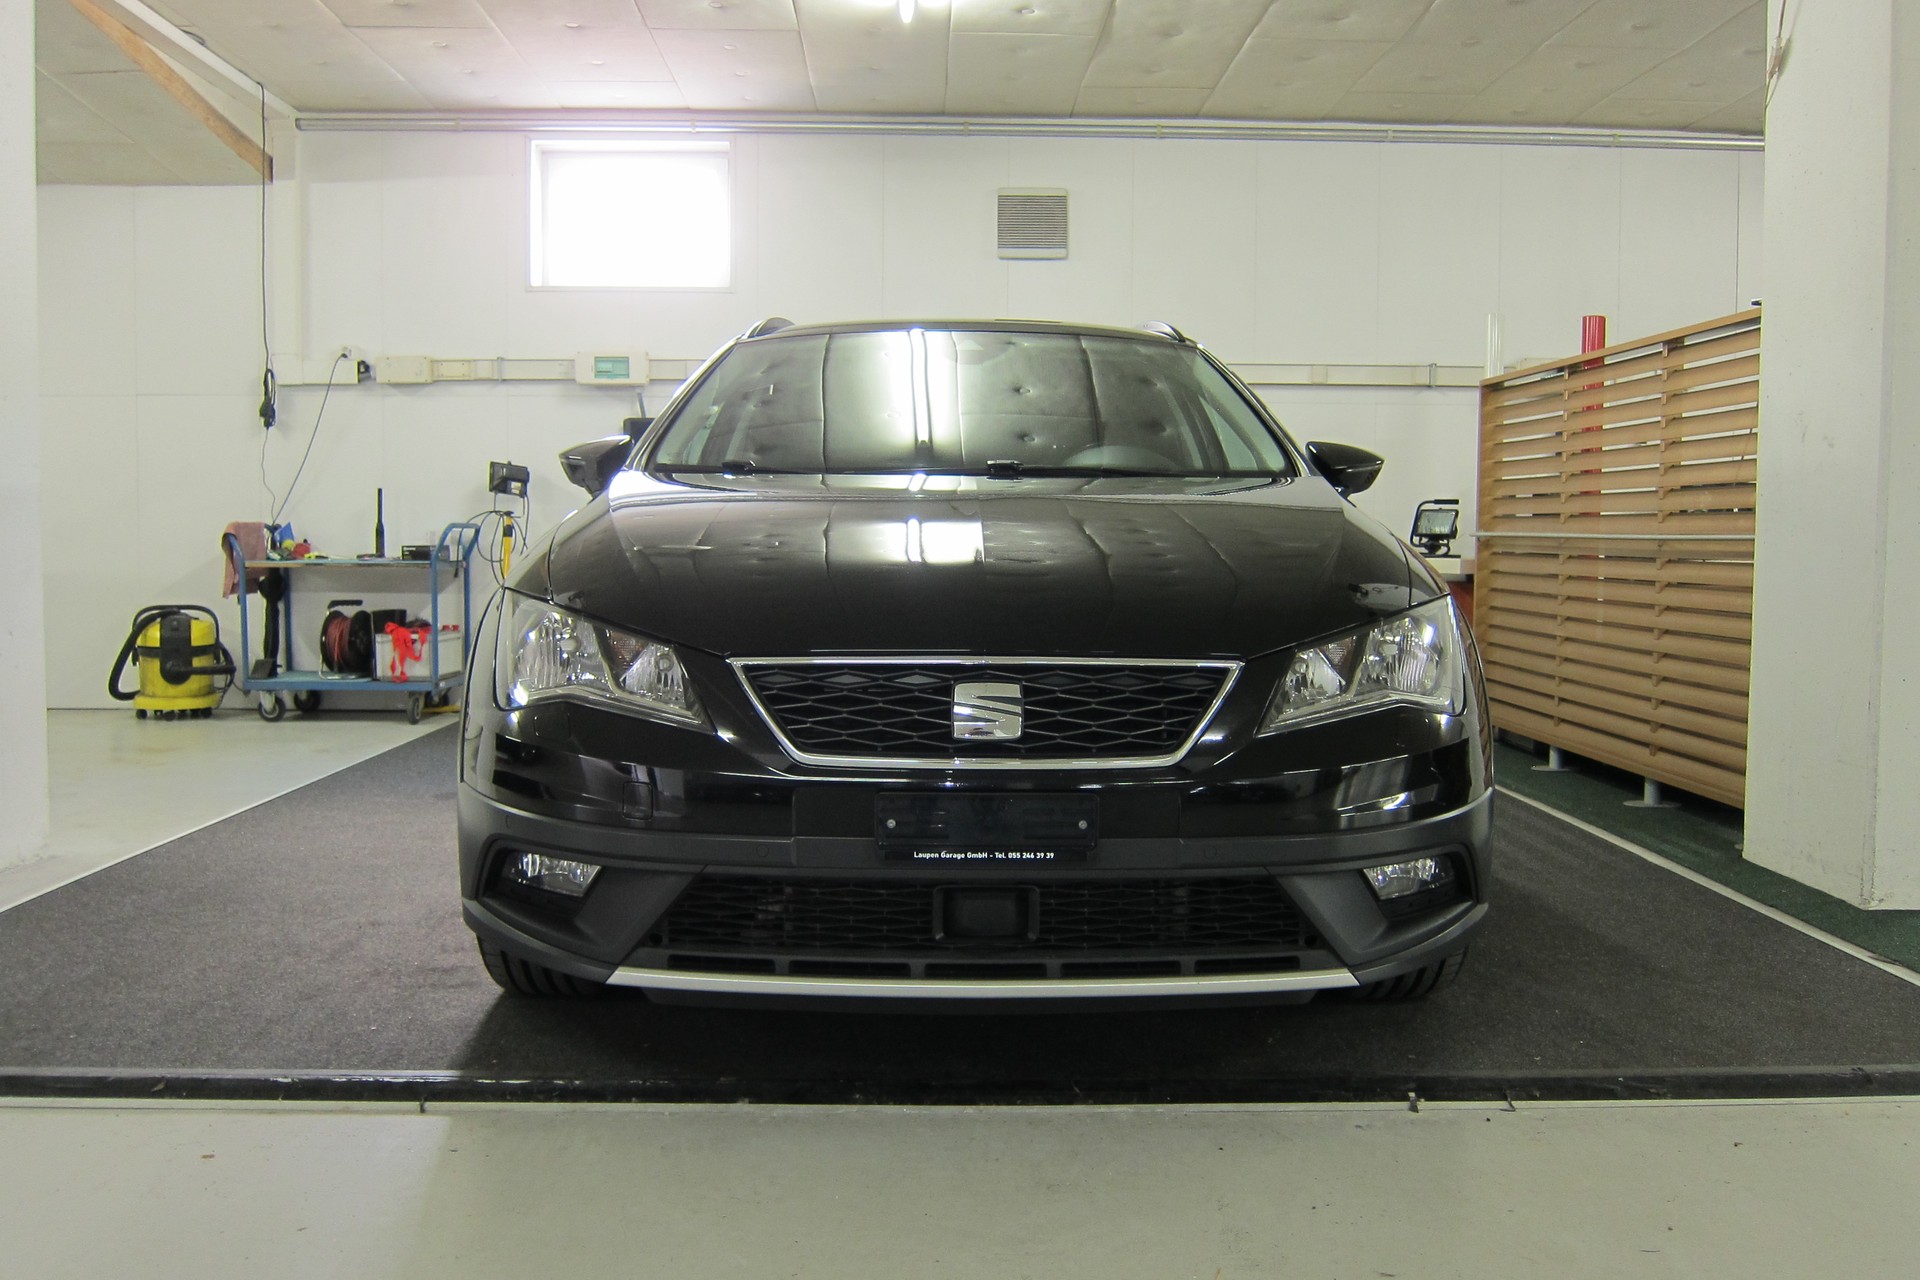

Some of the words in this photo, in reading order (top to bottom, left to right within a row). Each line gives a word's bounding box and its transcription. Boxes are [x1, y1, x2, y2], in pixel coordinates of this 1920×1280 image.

[914, 851, 939, 860] Laupen
[941, 851, 965, 860] Garage
[966, 851, 988, 859] GmbH
